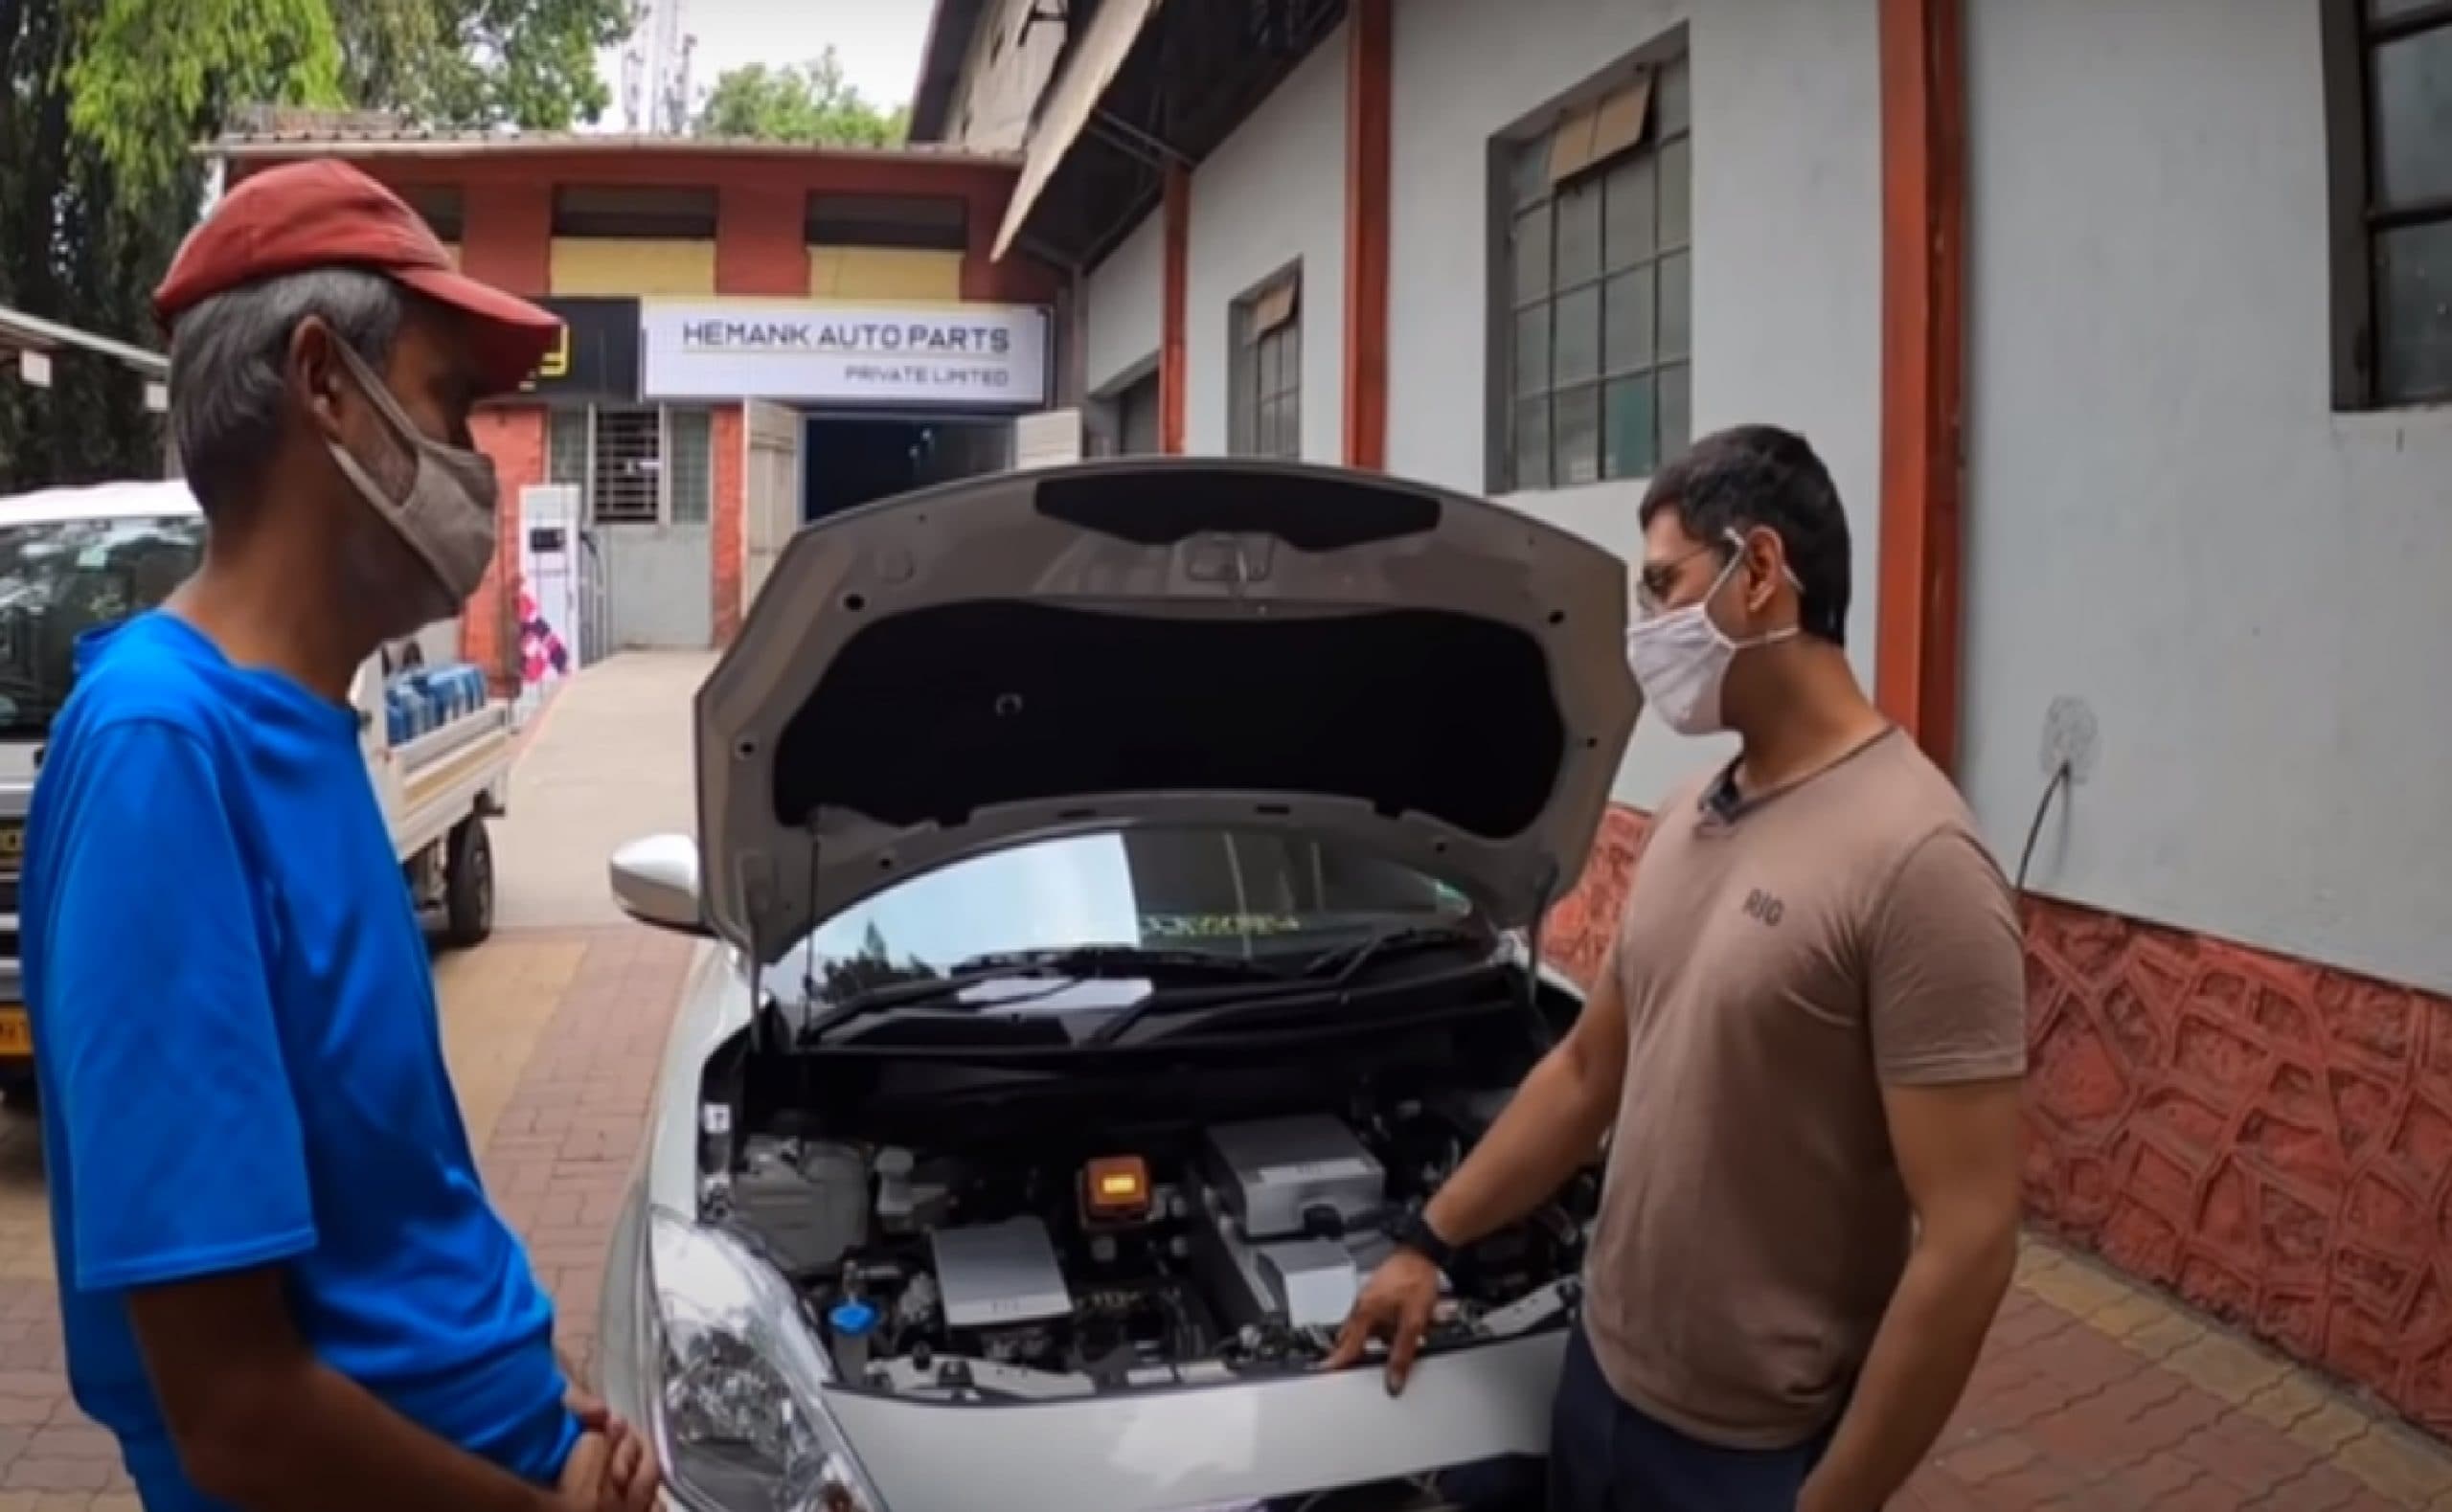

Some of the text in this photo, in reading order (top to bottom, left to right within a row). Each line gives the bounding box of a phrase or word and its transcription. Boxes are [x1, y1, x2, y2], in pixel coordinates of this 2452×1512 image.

[683, 321, 1010, 353] HEMANK AUTO PARTS
[844, 365, 1009, 387] PRIVATE LIMITED
